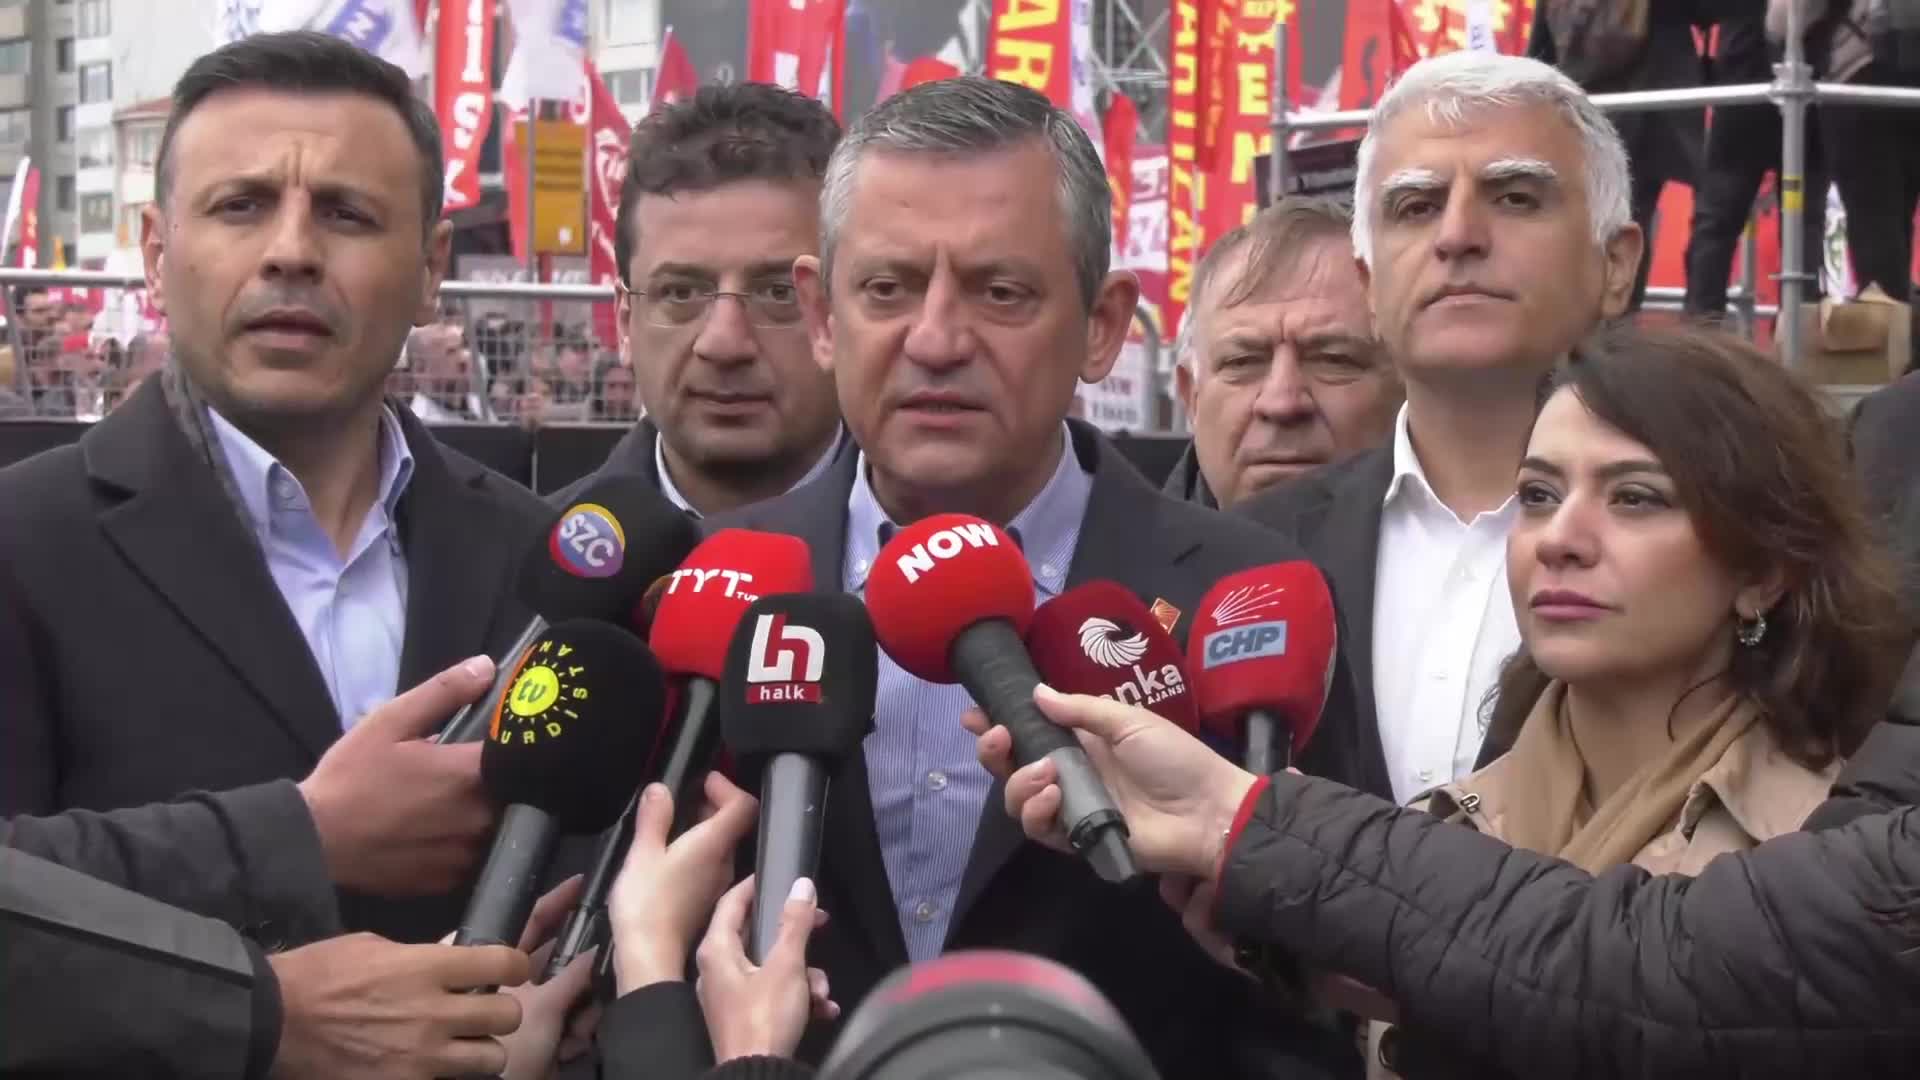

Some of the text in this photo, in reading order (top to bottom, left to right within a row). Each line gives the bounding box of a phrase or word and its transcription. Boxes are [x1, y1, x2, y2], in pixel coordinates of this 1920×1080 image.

[559, 514, 615, 569] SZC
[896, 521, 999, 583] NOW
[668, 568, 753, 598] TYT
[1208, 626, 1281, 659] CHP
[517, 678, 547, 703] tv
[759, 685, 805, 701] halk
[1099, 664, 1183, 707] nka
